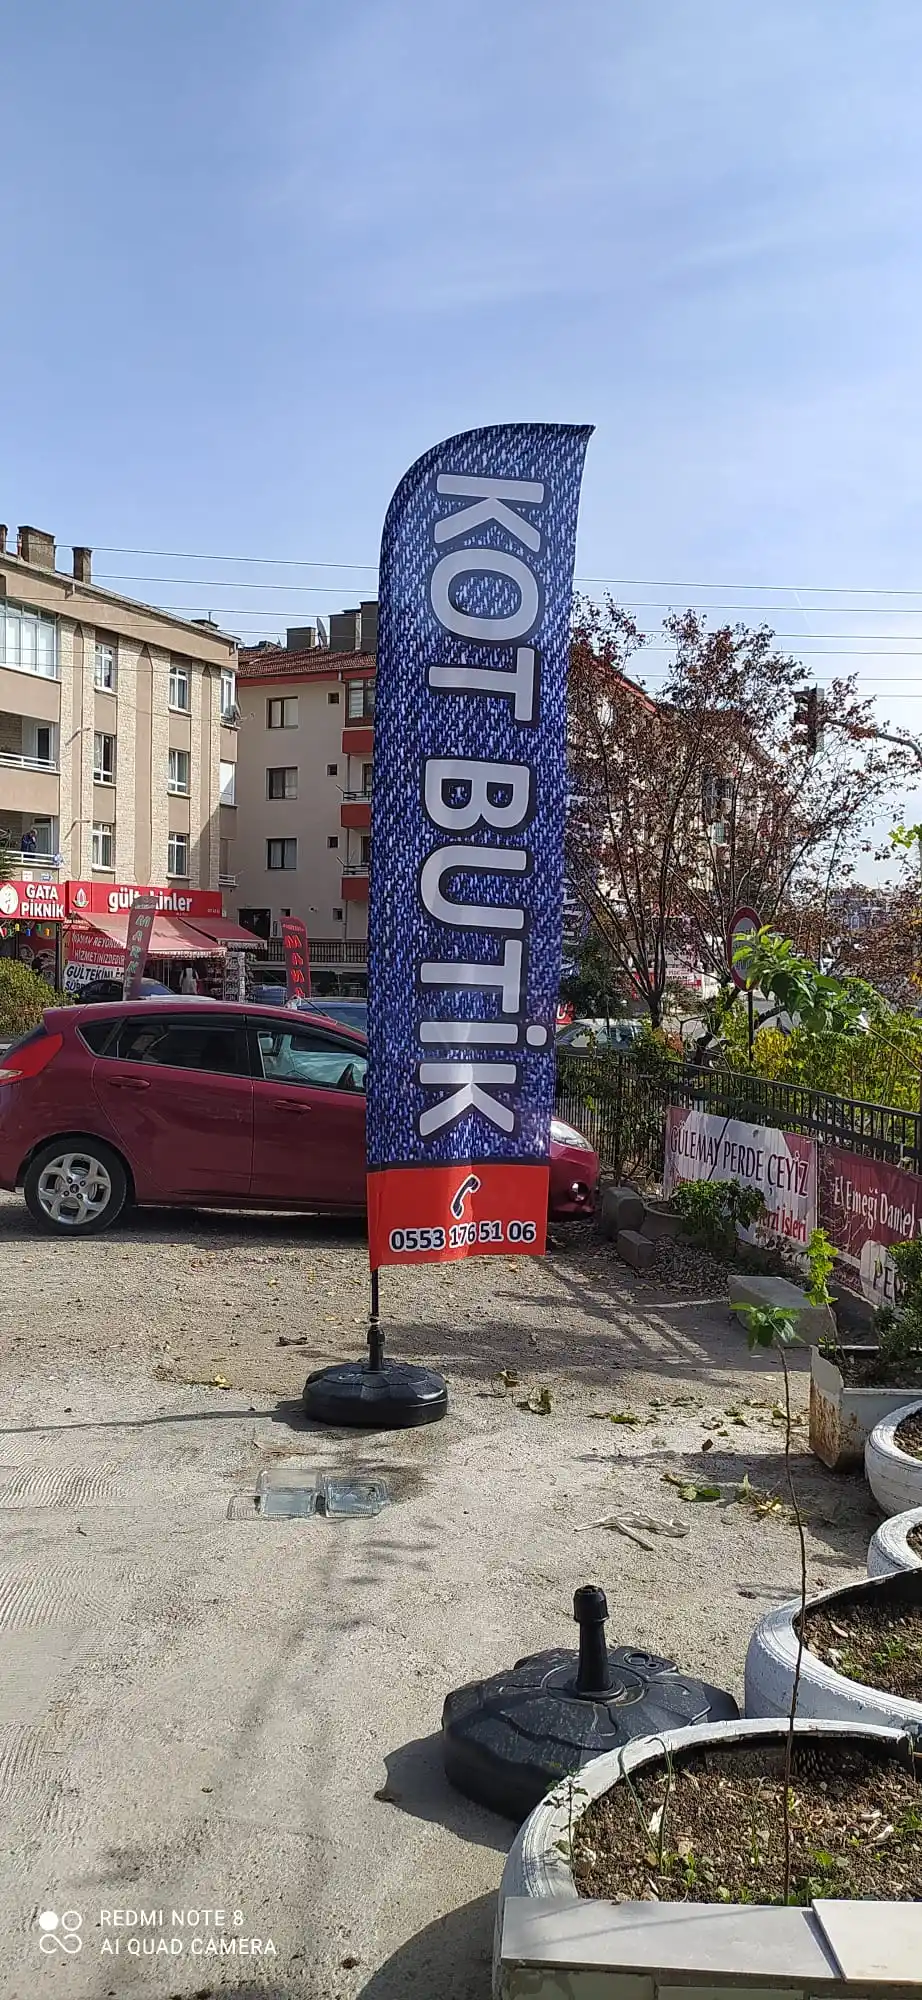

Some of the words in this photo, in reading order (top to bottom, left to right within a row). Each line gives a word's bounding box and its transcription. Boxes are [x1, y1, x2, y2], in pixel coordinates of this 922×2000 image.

[428, 473, 545, 722] KOT
[21, 898, 65, 918] PİKNİK
[26, 884, 59, 900] GATA
[108, 886, 193, 913] gülinler
[420, 758, 548, 1137] BUTİK
[670, 1121, 721, 1167] GÜLEMAY
[723, 1140, 765, 1181] PERDE
[767, 1151, 810, 1199] ÇEYİZ
[760, 1205, 779, 1232] erzi
[834, 1176, 844, 1206] El
[846, 1181, 879, 1230] Emeği
[389, 1227, 446, 1253] 0553
[449, 1222, 477, 1248] 176
[478, 1220, 503, 1242] 51
[507, 1220, 537, 1244] 06
